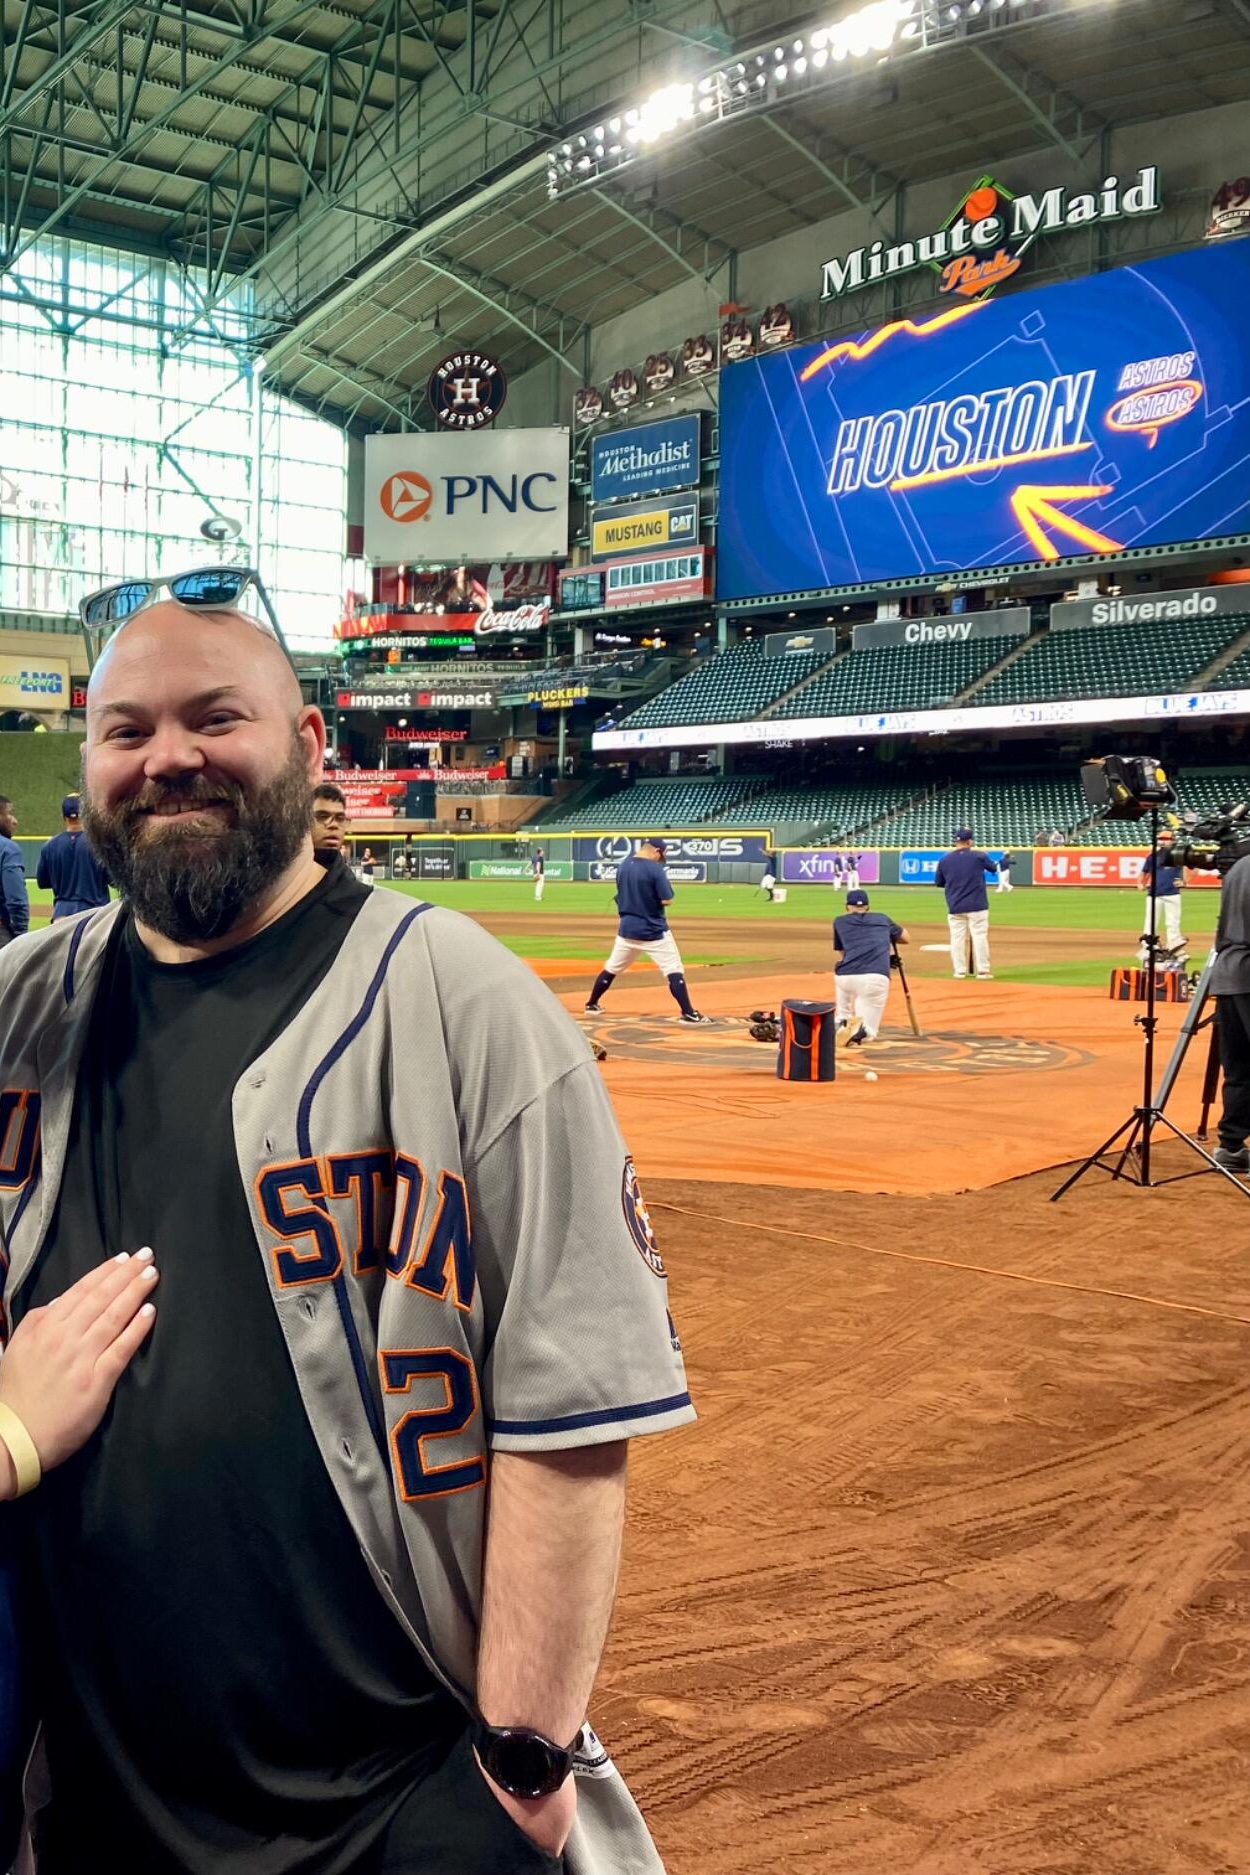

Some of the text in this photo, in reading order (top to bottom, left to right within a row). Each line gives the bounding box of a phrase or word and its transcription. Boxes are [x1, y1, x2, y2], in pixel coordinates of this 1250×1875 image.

[820, 166, 1159, 302] Minute Maid
[939, 249, 1021, 297] Park
[437, 355, 497, 378] HOUSTON
[1117, 351, 1196, 392] ASTROS
[453, 378, 481, 403] H
[439, 405, 493, 425] ASTROS
[1117, 387, 1195, 426] ASTROS
[827, 370, 1096, 494] HOUSTON
[598, 440, 691, 477] Methodist
[599, 446, 635, 459] HOUSTON
[623, 470, 653, 482] LEADING
[656, 463, 691, 476] MEDICINE
[440, 472, 558, 515] PNC
[606, 521, 662, 543] MUSTANG
[671, 514, 692, 533] CAT
[959, 576, 1010, 589] CHEVROLET
[1092, 592, 1218, 625] Silverado
[371, 637, 427, 647] HORNITOS
[905, 621, 973, 644] Chevy
[431, 663, 493, 673] HORNITOS
[21, 671, 63, 694] LNG
[350, 691, 411, 708] impact
[431, 691, 492, 708] impact
[528, 687, 589, 702] PLUCKERS
[385, 726, 467, 741] Budweiser
[764, 739, 793, 749] SHAKE
[335, 770, 397, 781] Budweiser
[434, 769, 489, 781] Budweiser
[691, 841, 711, 851] 370
[490, 865, 522, 875] National
[1041, 855, 1147, 877] H-E-B
